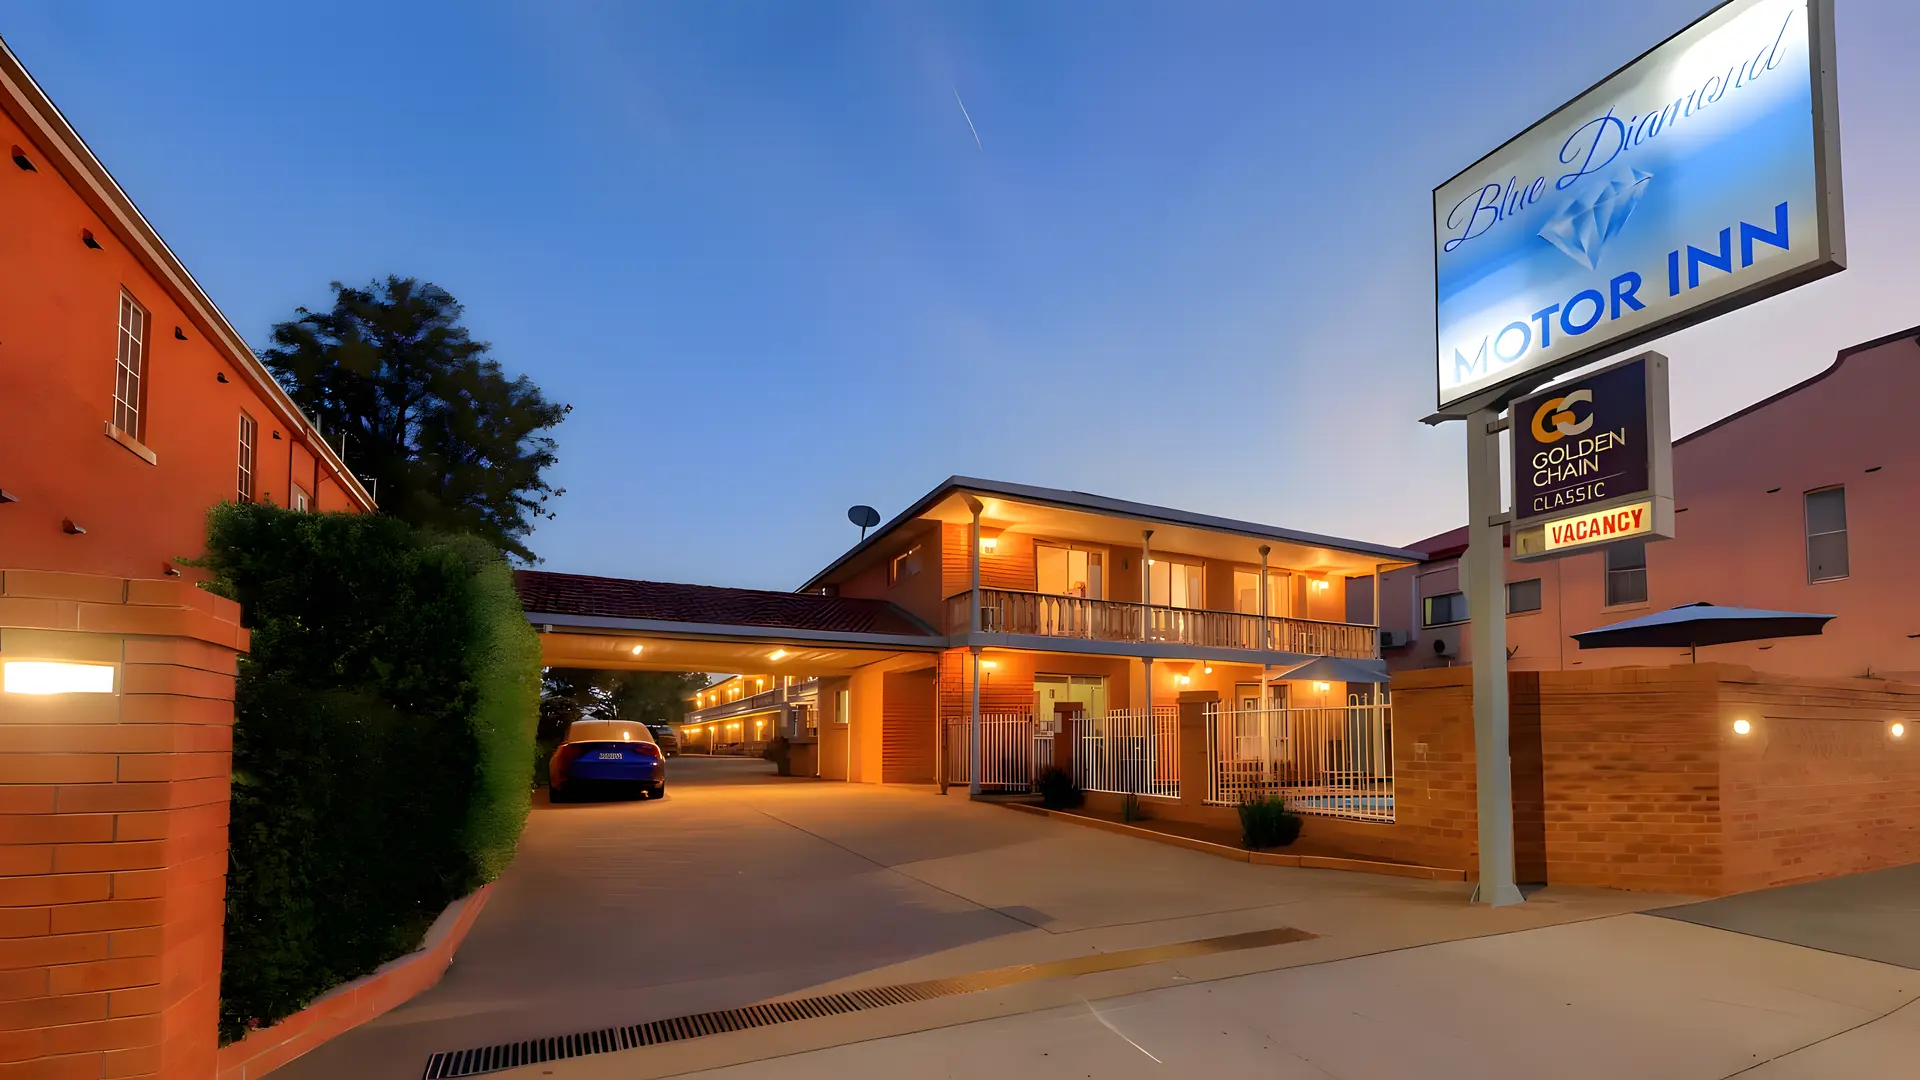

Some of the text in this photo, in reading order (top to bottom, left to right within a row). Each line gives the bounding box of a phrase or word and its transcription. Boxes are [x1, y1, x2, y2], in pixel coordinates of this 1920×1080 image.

[1444, 10, 1794, 252] Blue Diamond
[1454, 201, 1790, 383] MOTOR INN
[1532, 427, 1626, 469] GOLDEN
[1533, 454, 1599, 487] CHAIN
[1533, 482, 1605, 511] CLASSIC
[1552, 508, 1643, 544] VACANCY
